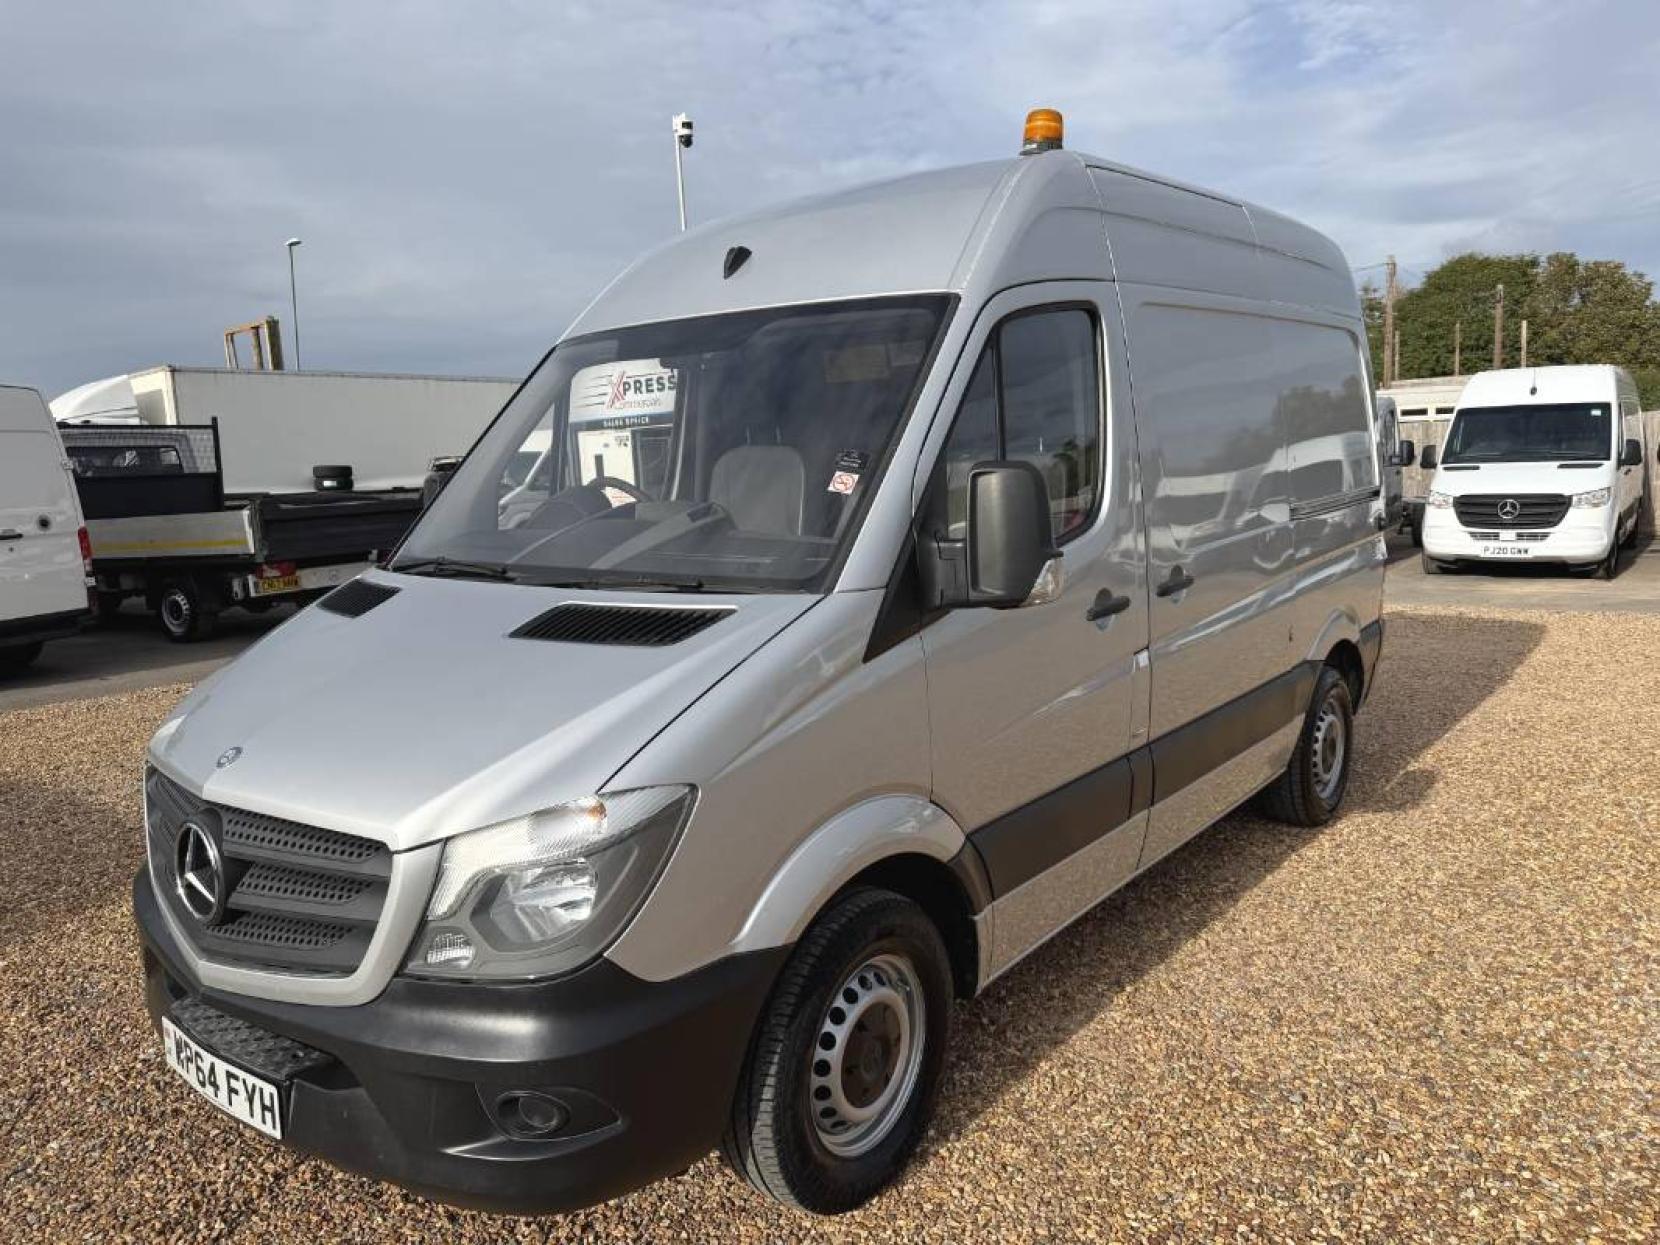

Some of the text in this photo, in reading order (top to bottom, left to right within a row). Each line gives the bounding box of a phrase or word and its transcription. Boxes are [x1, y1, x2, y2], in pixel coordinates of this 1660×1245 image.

[606, 371, 677, 408] XPRESS
[1483, 545, 1508, 555] PJ20
[225, 1069, 278, 1132] FYH
